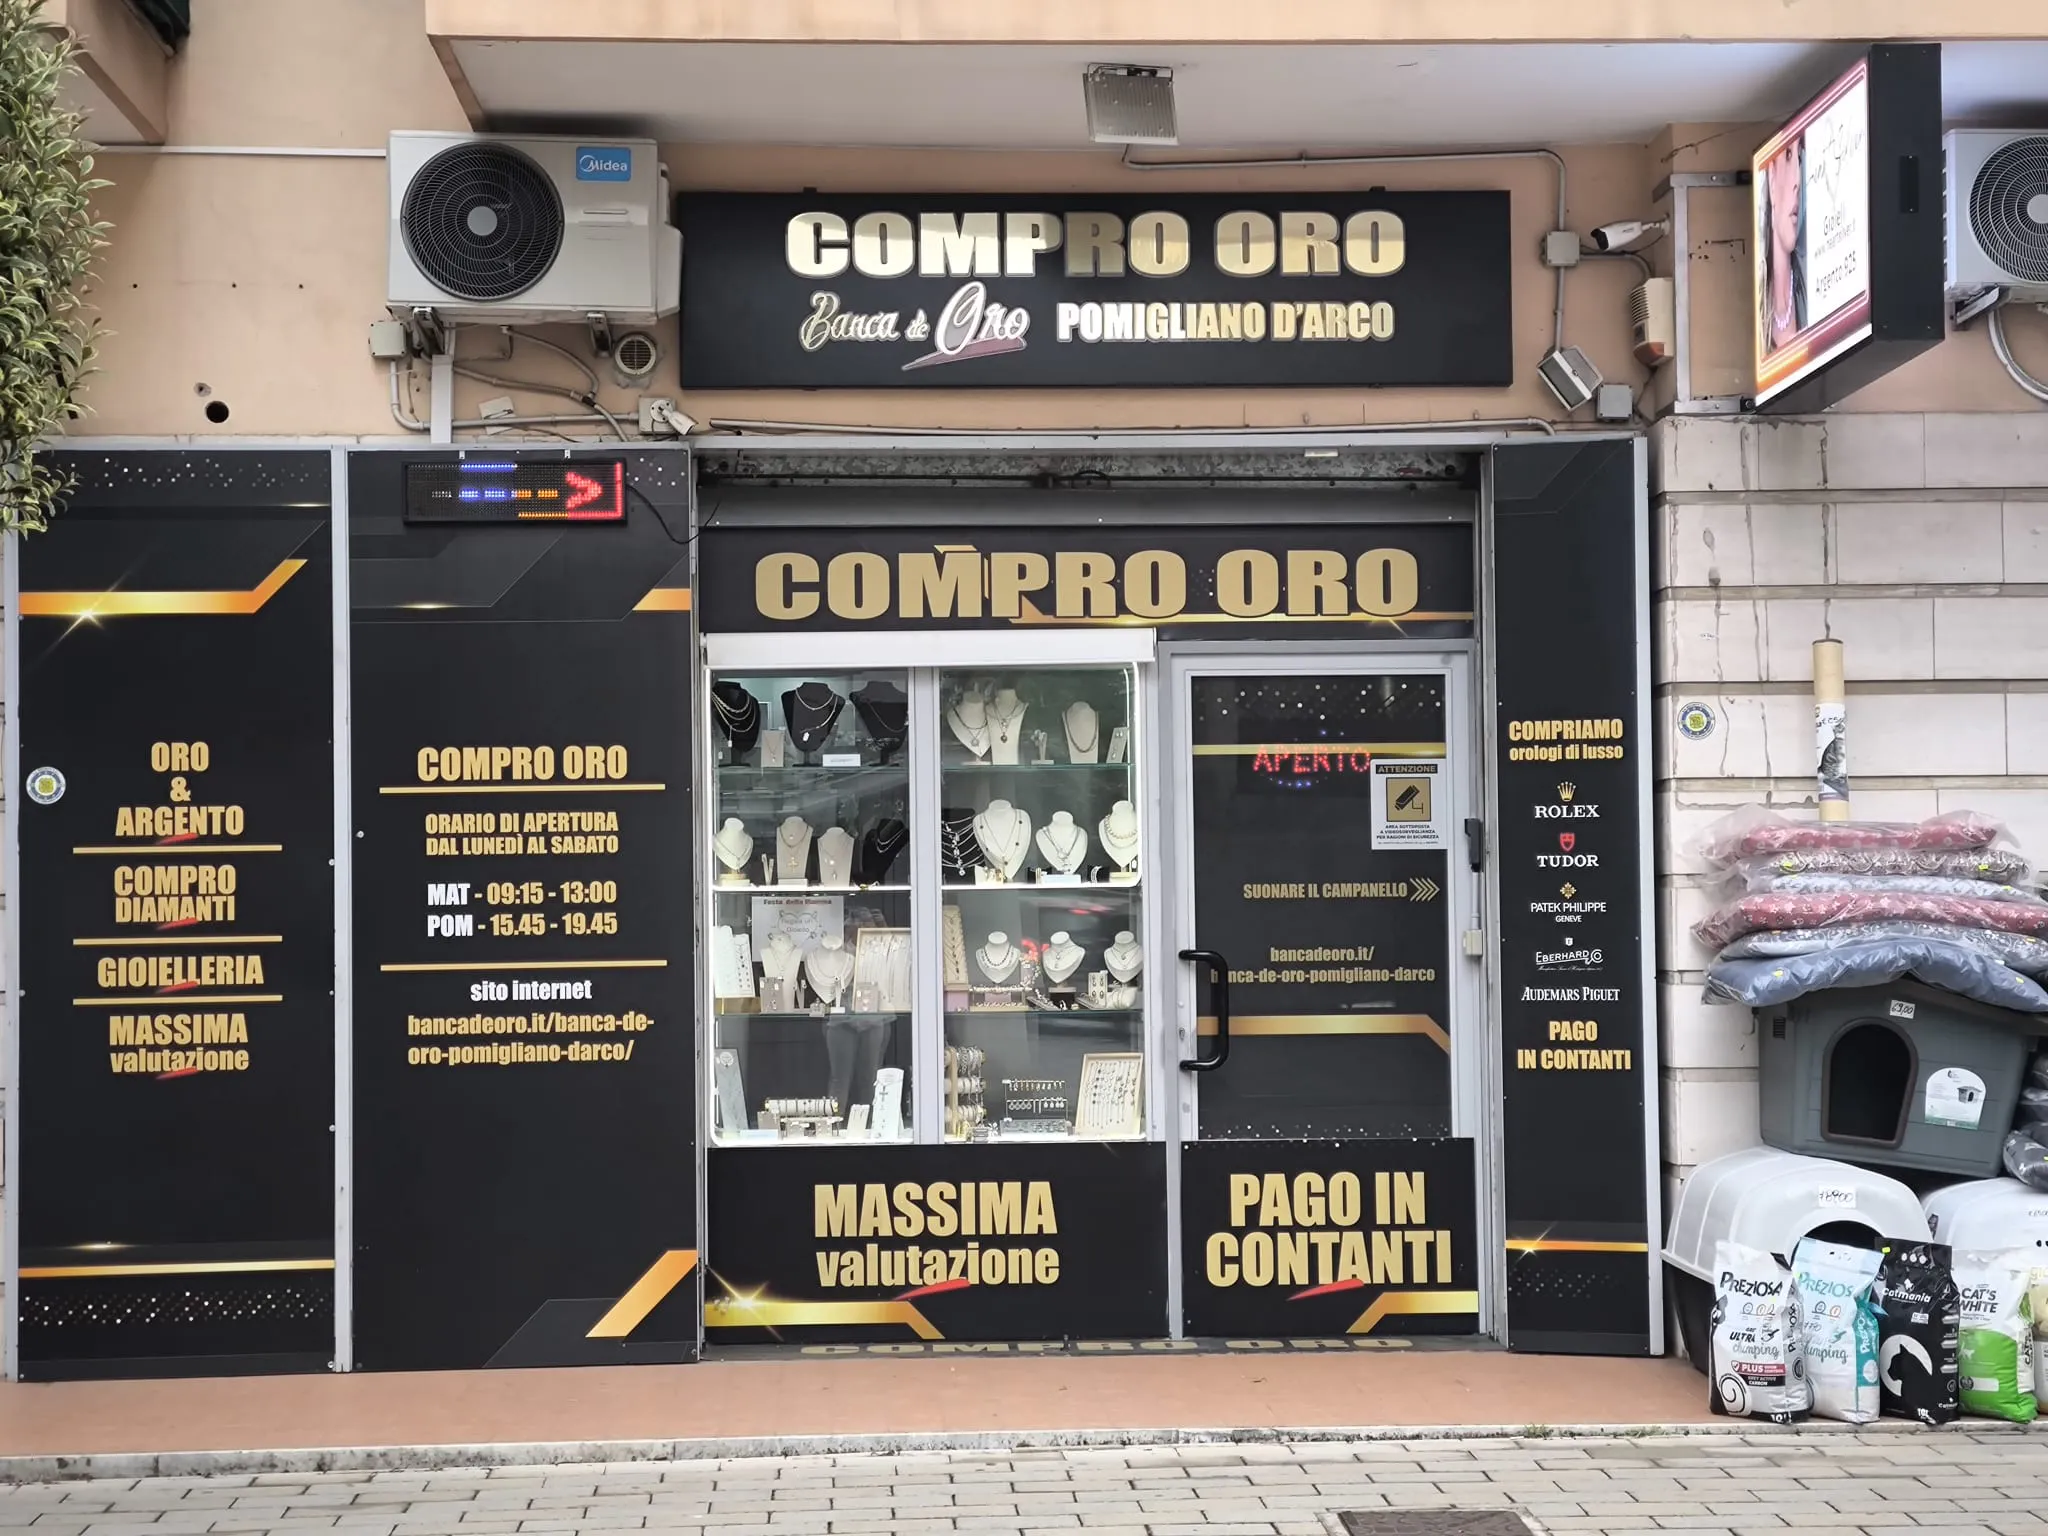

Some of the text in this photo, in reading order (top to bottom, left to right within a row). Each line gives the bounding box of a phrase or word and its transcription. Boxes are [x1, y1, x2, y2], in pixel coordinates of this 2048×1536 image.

[580, 155, 628, 172] Midea
[785, 210, 1406, 278] COMPRO ORO
[800, 291, 900, 351] Banca
[935, 281, 1030, 356] Oro
[1056, 301, 1265, 343] POMIGLIANO
[1271, 301, 1395, 342] D'ARCO
[755, 548, 1419, 620] COMPRO ORO
[1509, 718, 1624, 741] COMPRIAMO
[151, 742, 209, 772] ORO
[417, 745, 628, 781] COMPRO ORO
[1253, 745, 1371, 773] APERTO
[1509, 743, 1624, 761] orologi di lusso
[1378, 765, 1437, 773] ATTENZIONE
[170, 776, 191, 802] &
[115, 805, 244, 836] ARGENTO
[425, 811, 619, 834] ORARIO DI APERTURA
[1534, 805, 1600, 819] ROLEX
[426, 833, 619, 856] DAL LUNEDÌ AL SABATO
[1536, 855, 1599, 868] TUDOR
[114, 865, 236, 896] COMPRO
[1243, 882, 1408, 899] SUONARE IL CAMPANELLO
[427, 884, 470, 906] MAT
[486, 883, 544, 905] 09:15
[560, 881, 617, 903] 13:00
[115, 896, 235, 923] DIAMANTI
[1530, 902, 1607, 913] PATEK PHILIPPE
[1555, 915, 1583, 923] GENEVE
[427, 914, 473, 937] POM
[489, 914, 546, 936] 15.45
[562, 912, 618, 935] 19.45
[1270, 945, 1375, 962] bancadeoro.it/
[98, 955, 264, 987] GIOIELLERIA
[1210, 965, 1436, 984] bnca-de-oro-pomigliano-darco
[470, 980, 592, 1001] sito internet
[1521, 986, 1621, 1001] AUDEMARS PIGUET
[109, 1014, 249, 1045] MASSIMA
[408, 1011, 654, 1036] bancadeoro.it/banca-de-
[1549, 1020, 1598, 1042] PAGO
[110, 1047, 249, 1073] valutazione
[408, 1040, 635, 1066] oro-pomigliano-darco/
[1517, 1048, 1632, 1071] IN CONTANTI
[814, 1181, 1058, 1238] MASSIMA
[1229, 1171, 1426, 1227] PAGO IN
[815, 1242, 1060, 1289] valutazione
[1206, 1229, 1453, 1288] CONTANTI
[1719, 1271, 1784, 1297] PREZIOSA
[1882, 1287, 1932, 1303] catmania
[1961, 1287, 1997, 1302] CAT'S
[801, 1338, 1414, 1354] COMPRO ORO
[1741, 1364, 1764, 1373] PLUS
